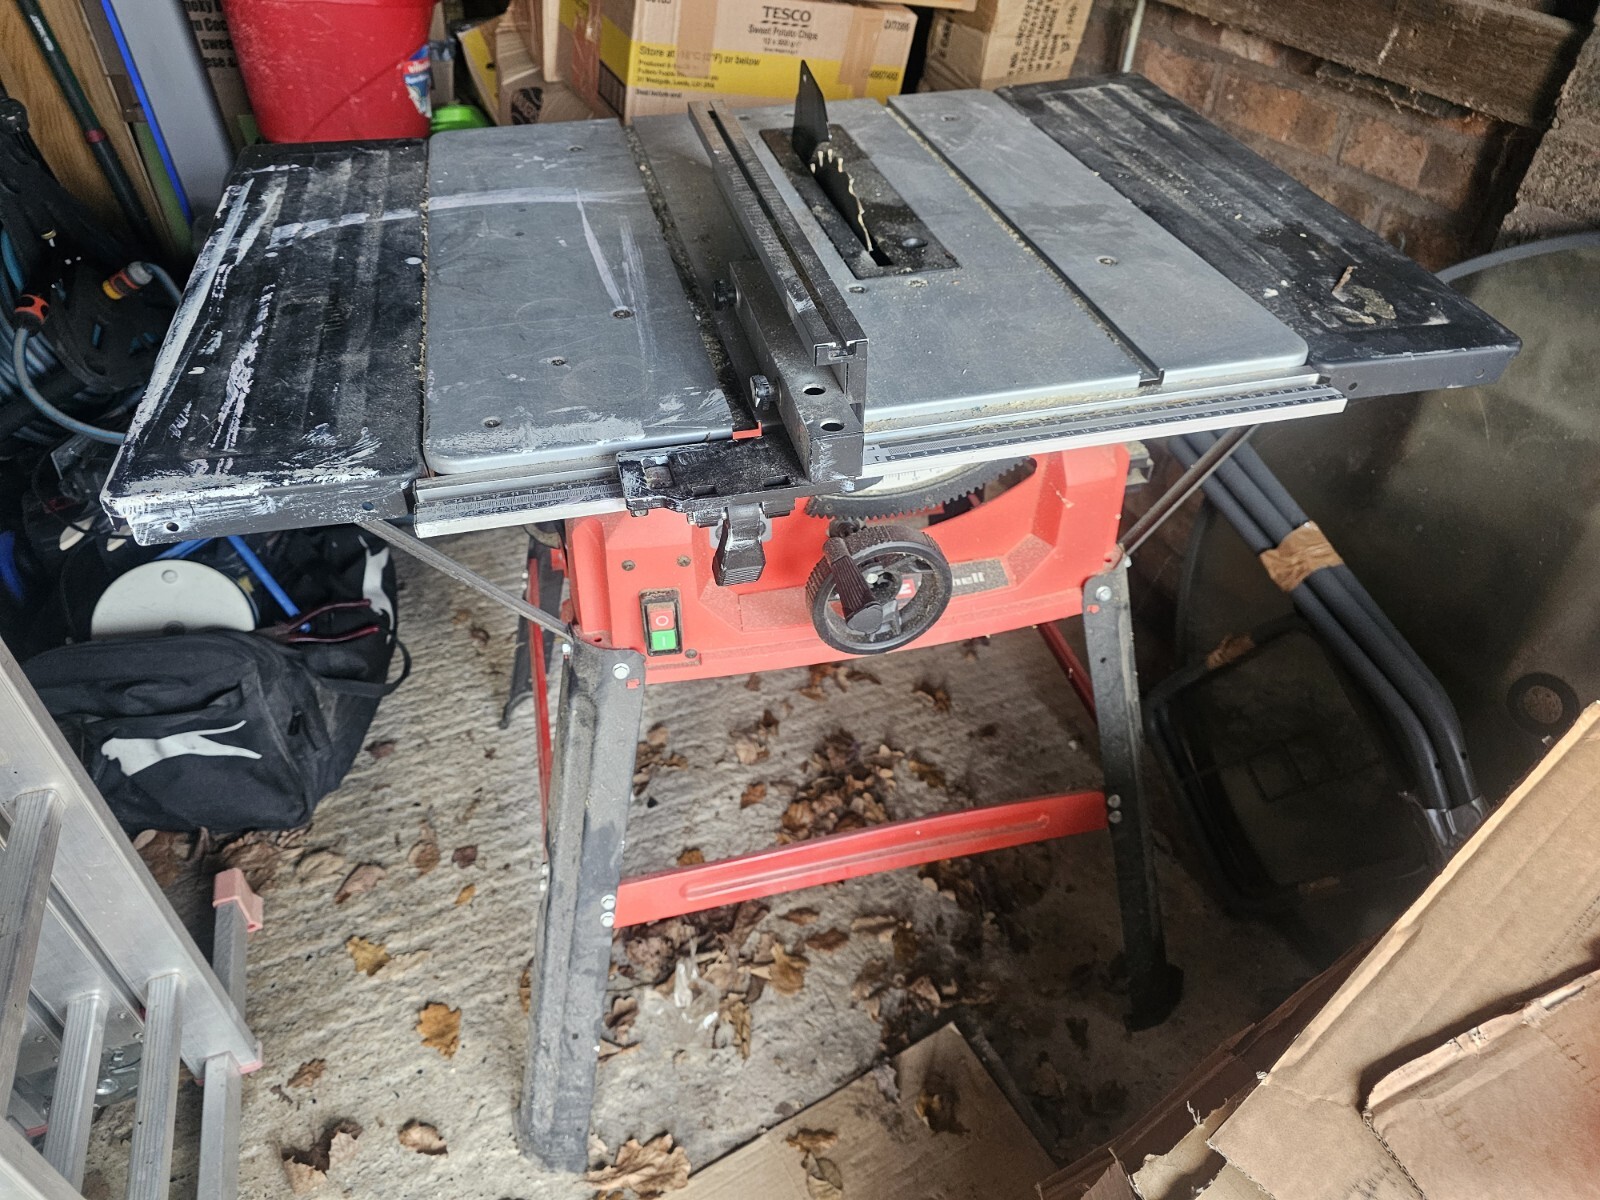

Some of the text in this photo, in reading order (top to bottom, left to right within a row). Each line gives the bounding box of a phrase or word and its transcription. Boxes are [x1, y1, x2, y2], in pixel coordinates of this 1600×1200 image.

[762, 5, 811, 22] TESCO
[748, 24, 819, 41] Sweet Potato Chips
[640, 46, 664, 57] Store
[735, 56, 760, 66] below
[952, 572, 985, 586] hell
